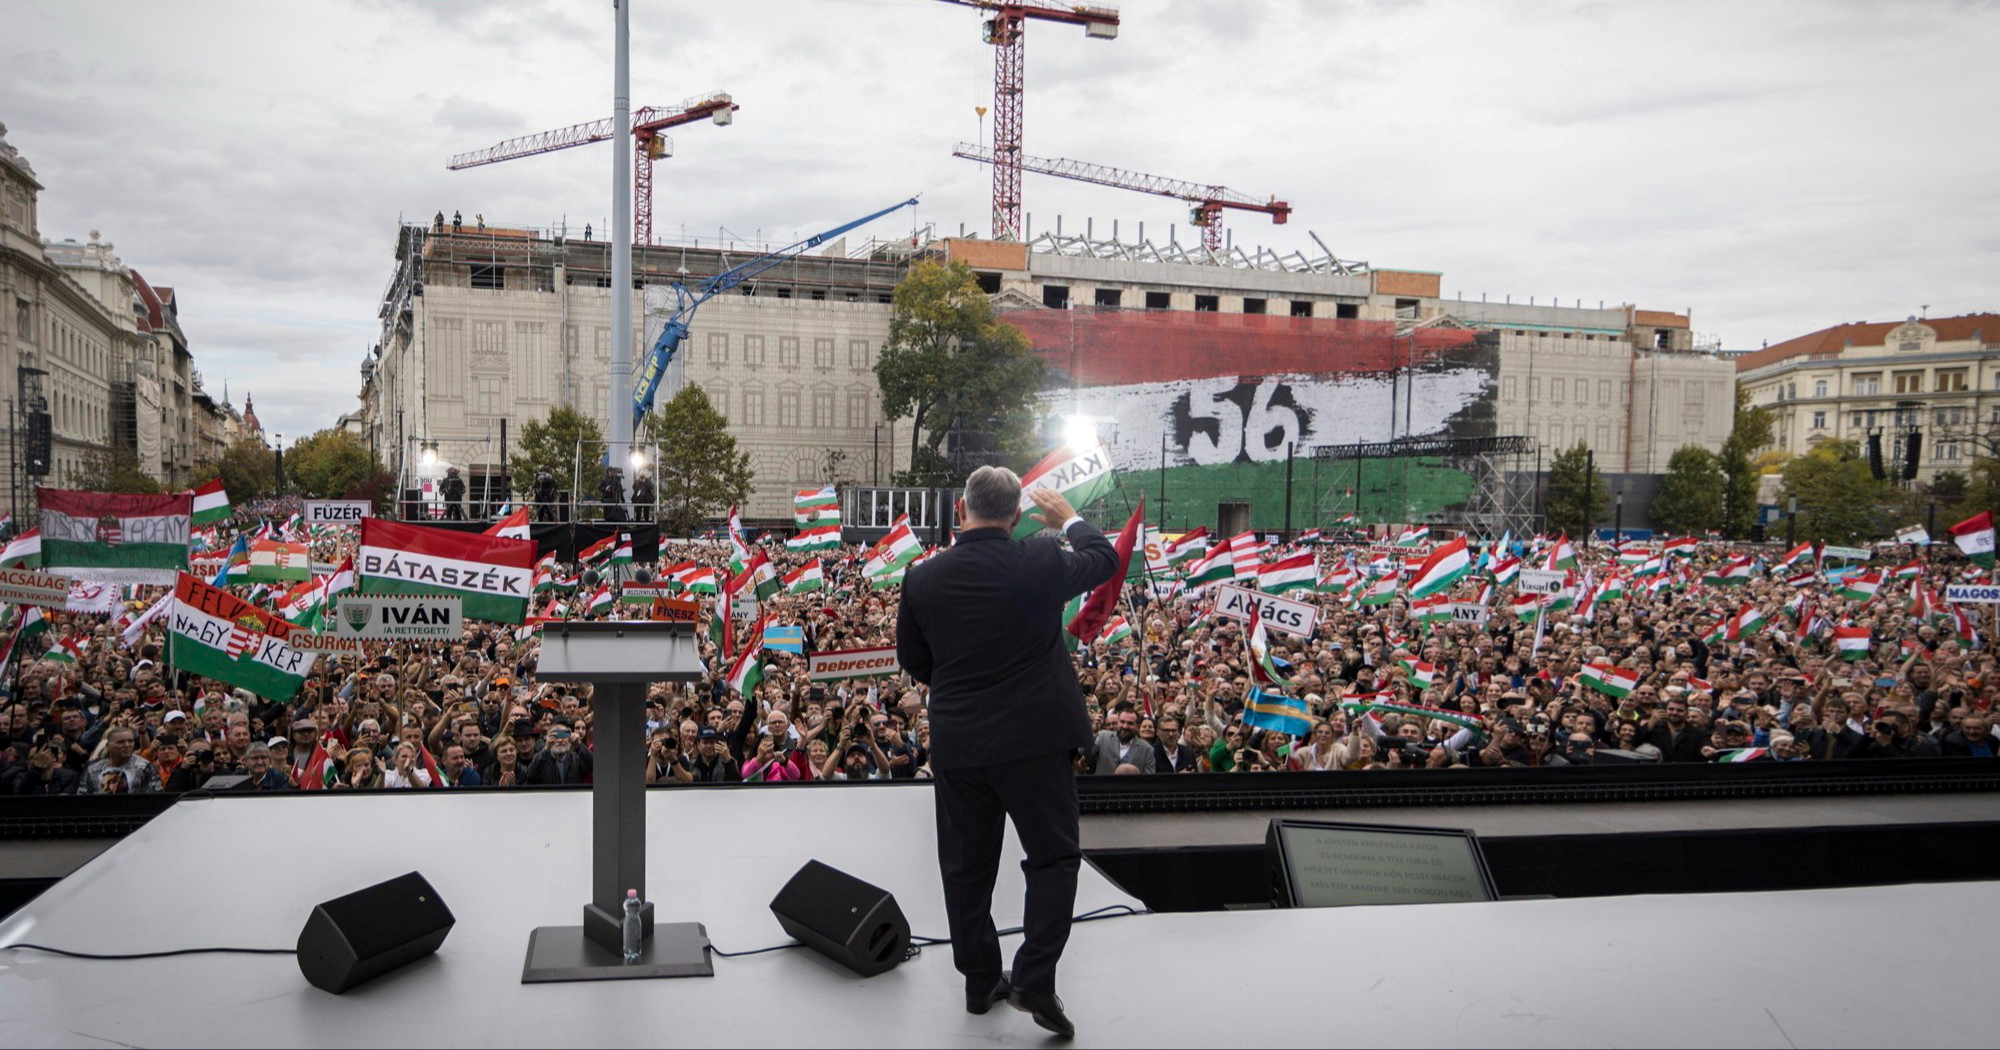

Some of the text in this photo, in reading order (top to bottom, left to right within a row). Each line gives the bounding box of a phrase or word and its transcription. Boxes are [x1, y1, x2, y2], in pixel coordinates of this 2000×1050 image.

[1187, 375, 1301, 467] 56
[313, 503, 362, 520] FÜZÉR
[365, 553, 522, 593] BÁTASZÉK
[1521, 579, 1548, 591] Vasad
[1948, 588, 2000, 599] MAGOS
[27, 592, 66, 603] VAGYUNK
[382, 603, 450, 625] IVÁN
[656, 606, 695, 621] FIDESZ
[394, 626, 450, 635] RETTEGETT/
[291, 634, 358, 652] CSORNA
[816, 656, 895, 673] Debrecen
